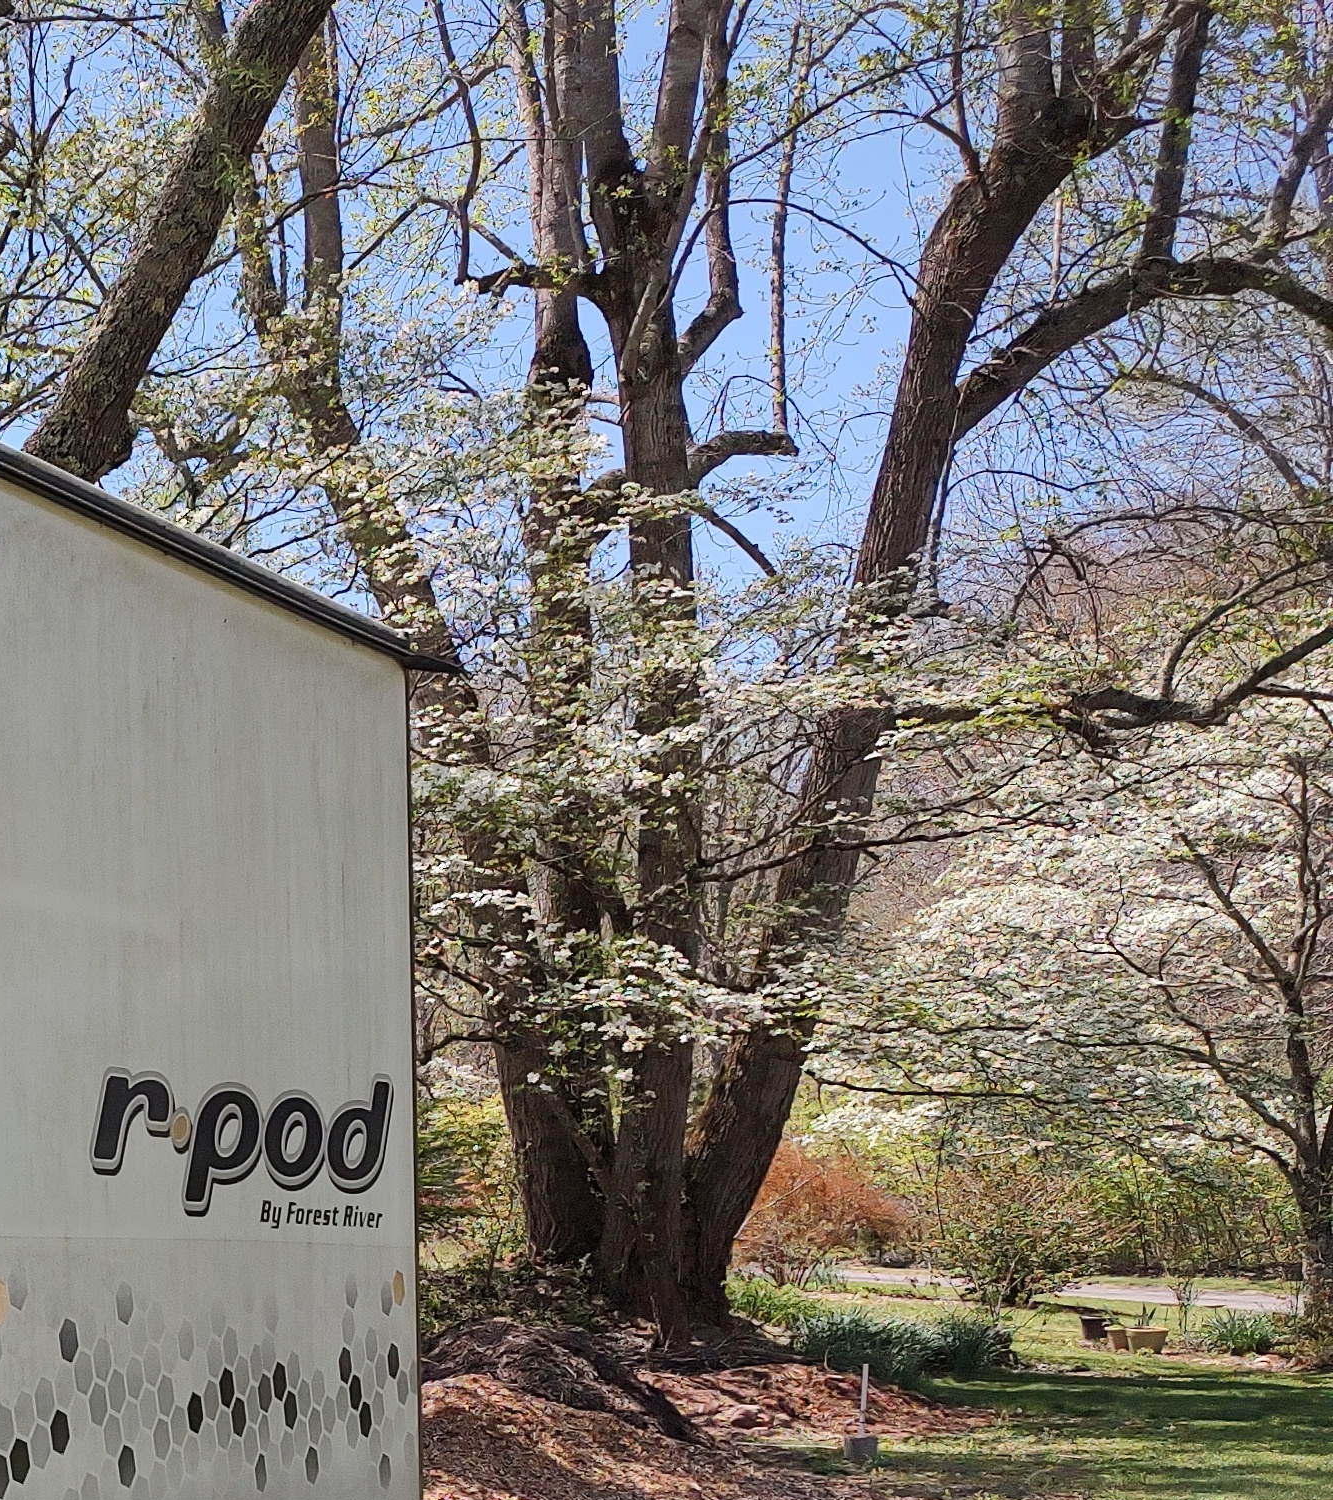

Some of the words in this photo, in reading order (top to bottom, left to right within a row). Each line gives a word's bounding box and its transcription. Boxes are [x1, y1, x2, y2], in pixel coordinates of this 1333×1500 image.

[259, 1199, 282, 1229] By
[286, 1201, 339, 1226] Forest
[342, 1205, 383, 1228] River
